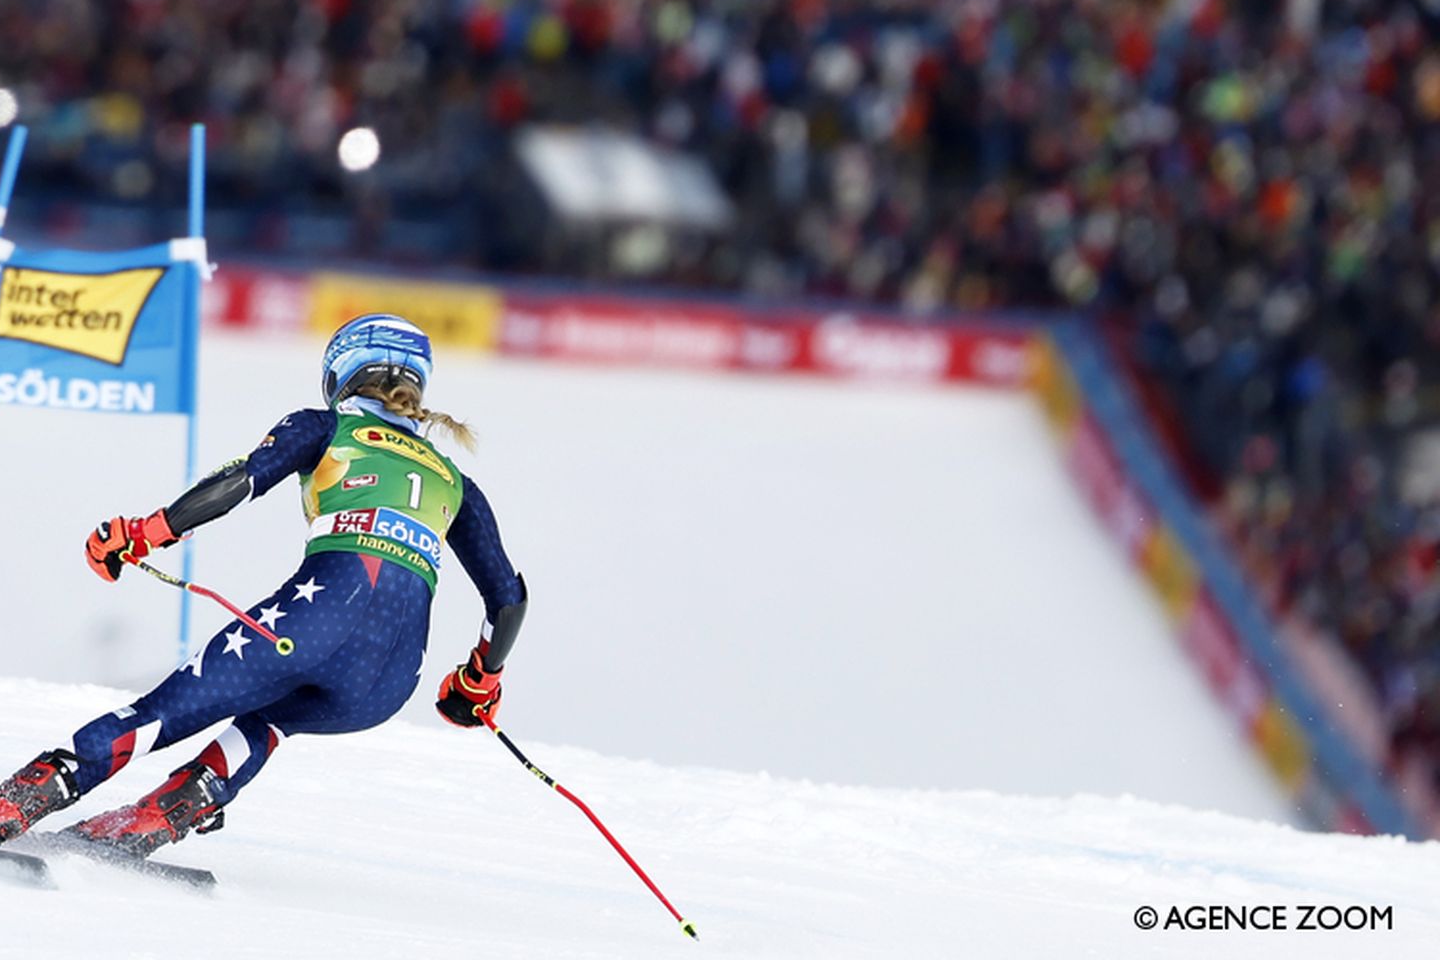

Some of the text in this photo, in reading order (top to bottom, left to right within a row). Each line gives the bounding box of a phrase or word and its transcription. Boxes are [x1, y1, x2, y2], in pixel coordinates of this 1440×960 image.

[7, 272, 85, 307] inter
[406, 471, 423, 511] 1
[337, 523, 366, 533] TAL
[377, 520, 441, 562] SÖLDE
